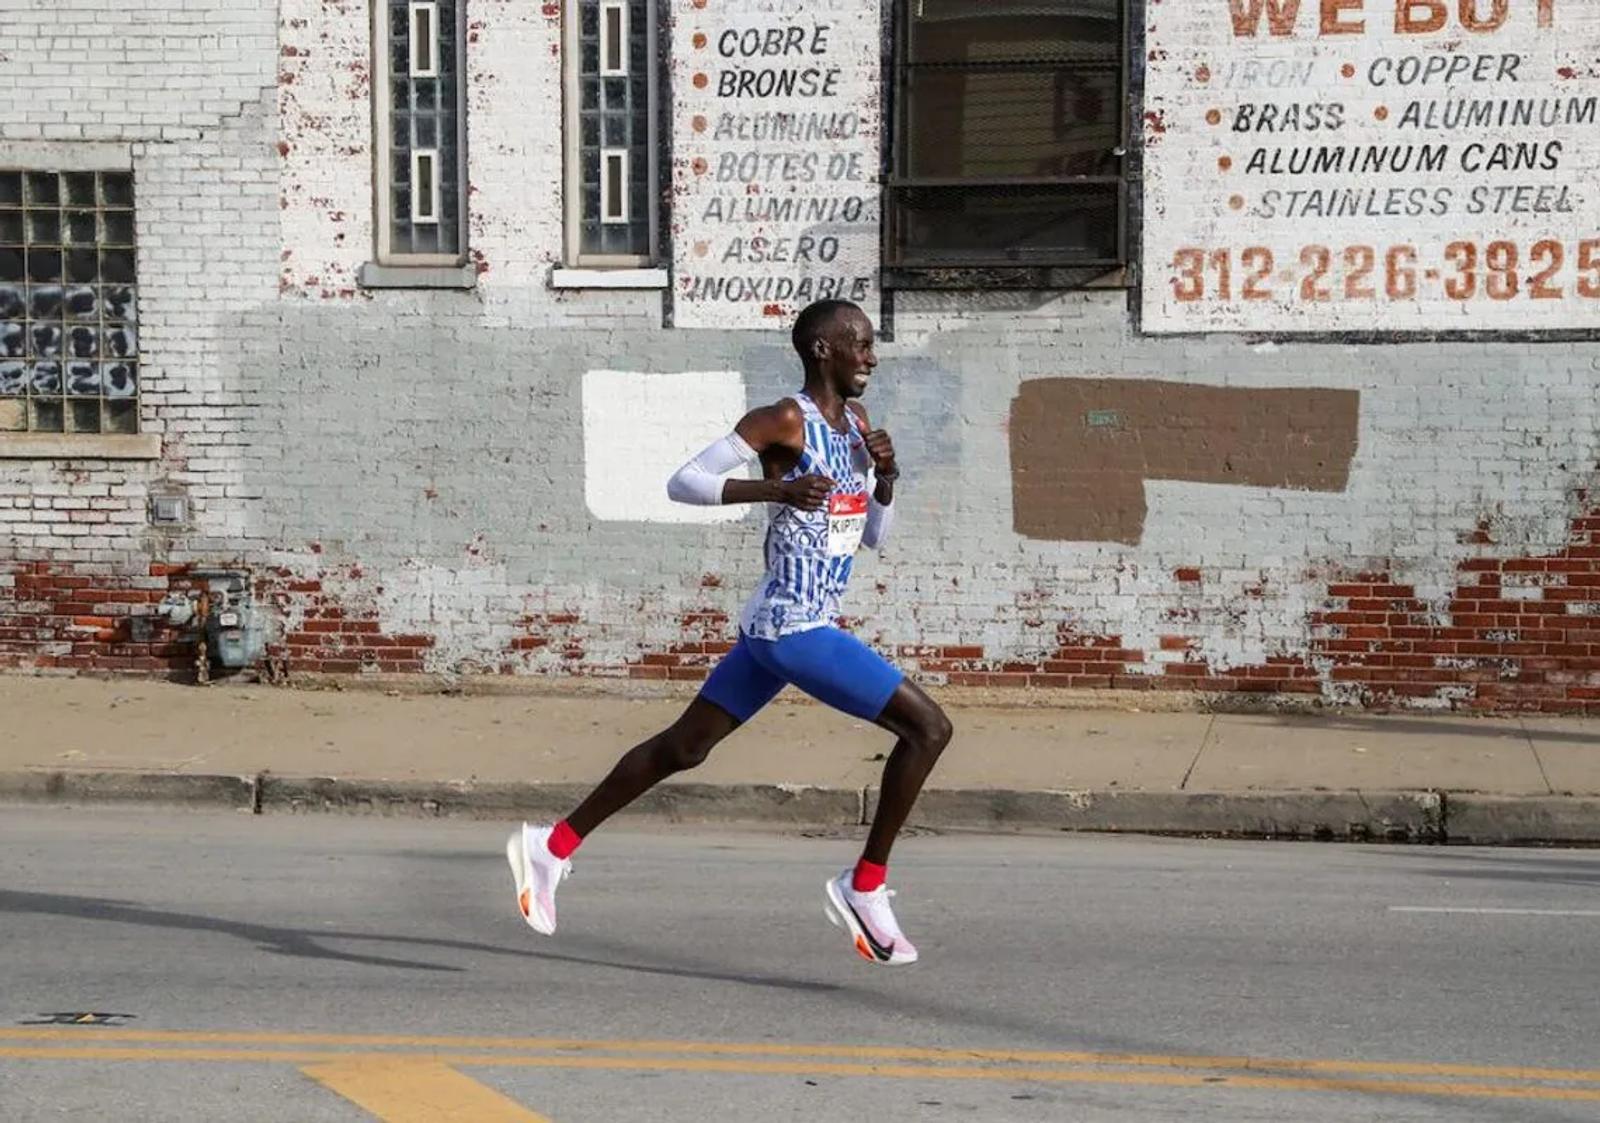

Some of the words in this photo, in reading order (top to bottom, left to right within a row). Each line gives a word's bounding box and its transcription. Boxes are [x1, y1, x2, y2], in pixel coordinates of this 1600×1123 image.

[1228, 0, 1365, 36] WE
[718, 26, 830, 57] COBRE
[717, 68, 841, 98] BRONSE
[1226, 61, 1314, 88] IRON
[1368, 54, 1521, 86] COPPER
[713, 112, 858, 141] ALUMINIO
[1232, 103, 1345, 132] BRASS
[1398, 97, 1598, 129] ALUMINUM
[717, 151, 819, 183] BOTES
[827, 152, 863, 182] DE
[1245, 145, 1448, 174] ALUMINUM
[1461, 140, 1563, 172] CANS
[702, 196, 863, 222] ALUMINIO
[1259, 187, 1453, 219] STAINLESS
[1467, 185, 1573, 214] STEEL
[722, 236, 839, 263] ASERO
[1173, 240, 1600, 301] 312-226-3825
[687, 276, 870, 302] INOXIDABLE
